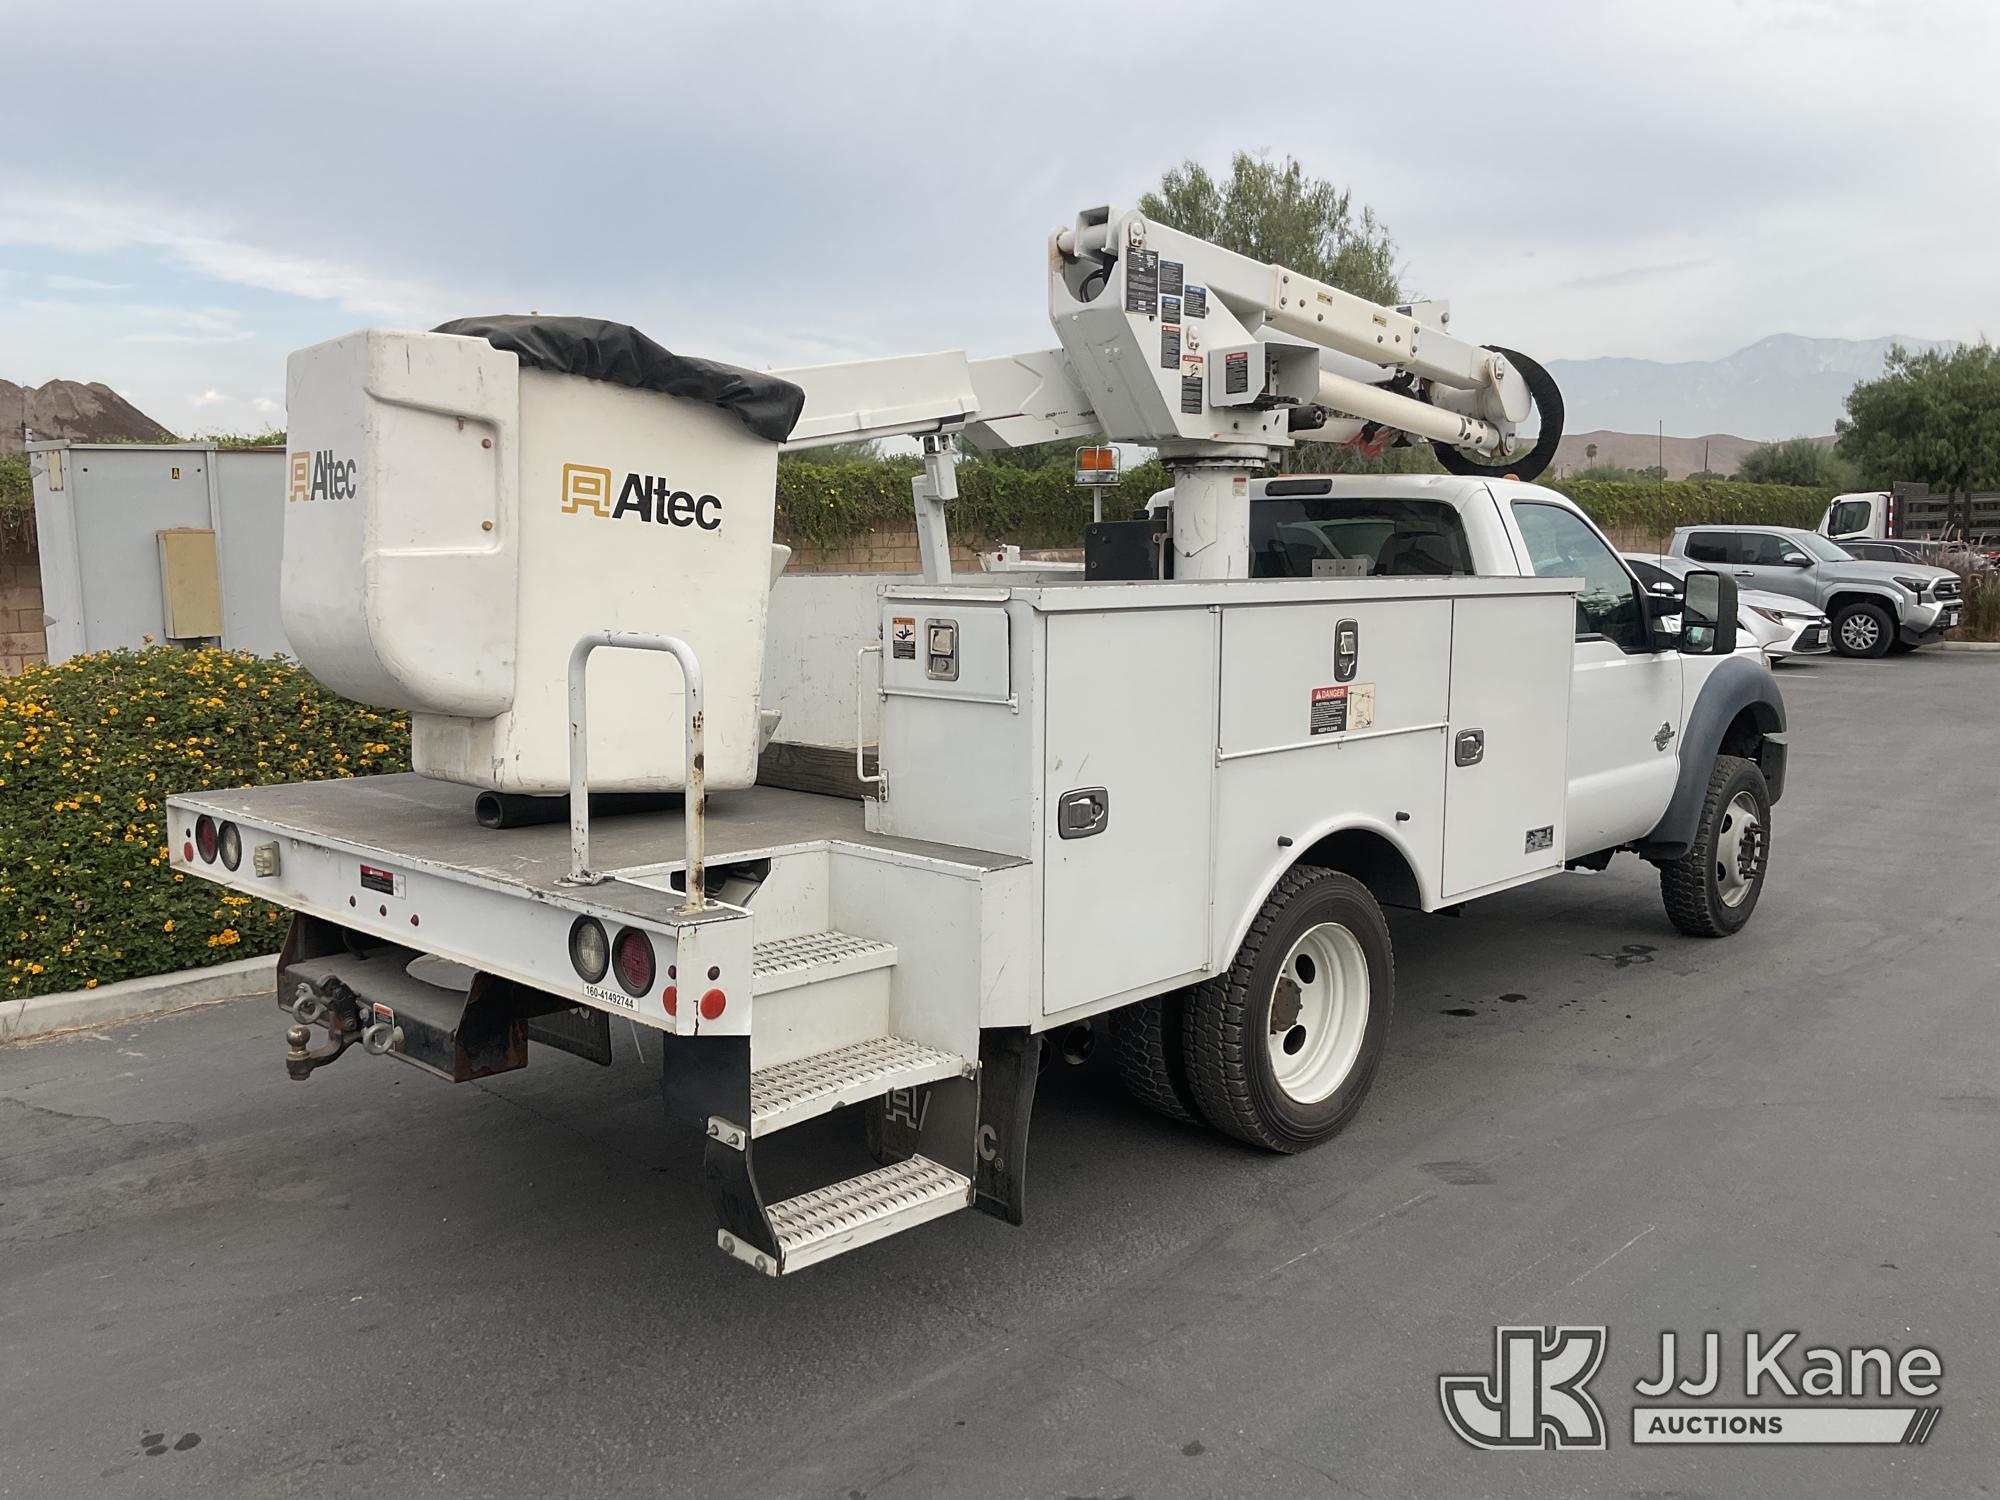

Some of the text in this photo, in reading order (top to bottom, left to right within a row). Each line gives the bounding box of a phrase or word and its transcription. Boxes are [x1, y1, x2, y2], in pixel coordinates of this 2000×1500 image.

[173, 468, 179, 479] A
[311, 449, 356, 501] Altec
[612, 473, 722, 530] Altec
[1321, 688, 1345, 698] DANGER
[586, 985, 634, 1008] 160-41492744
